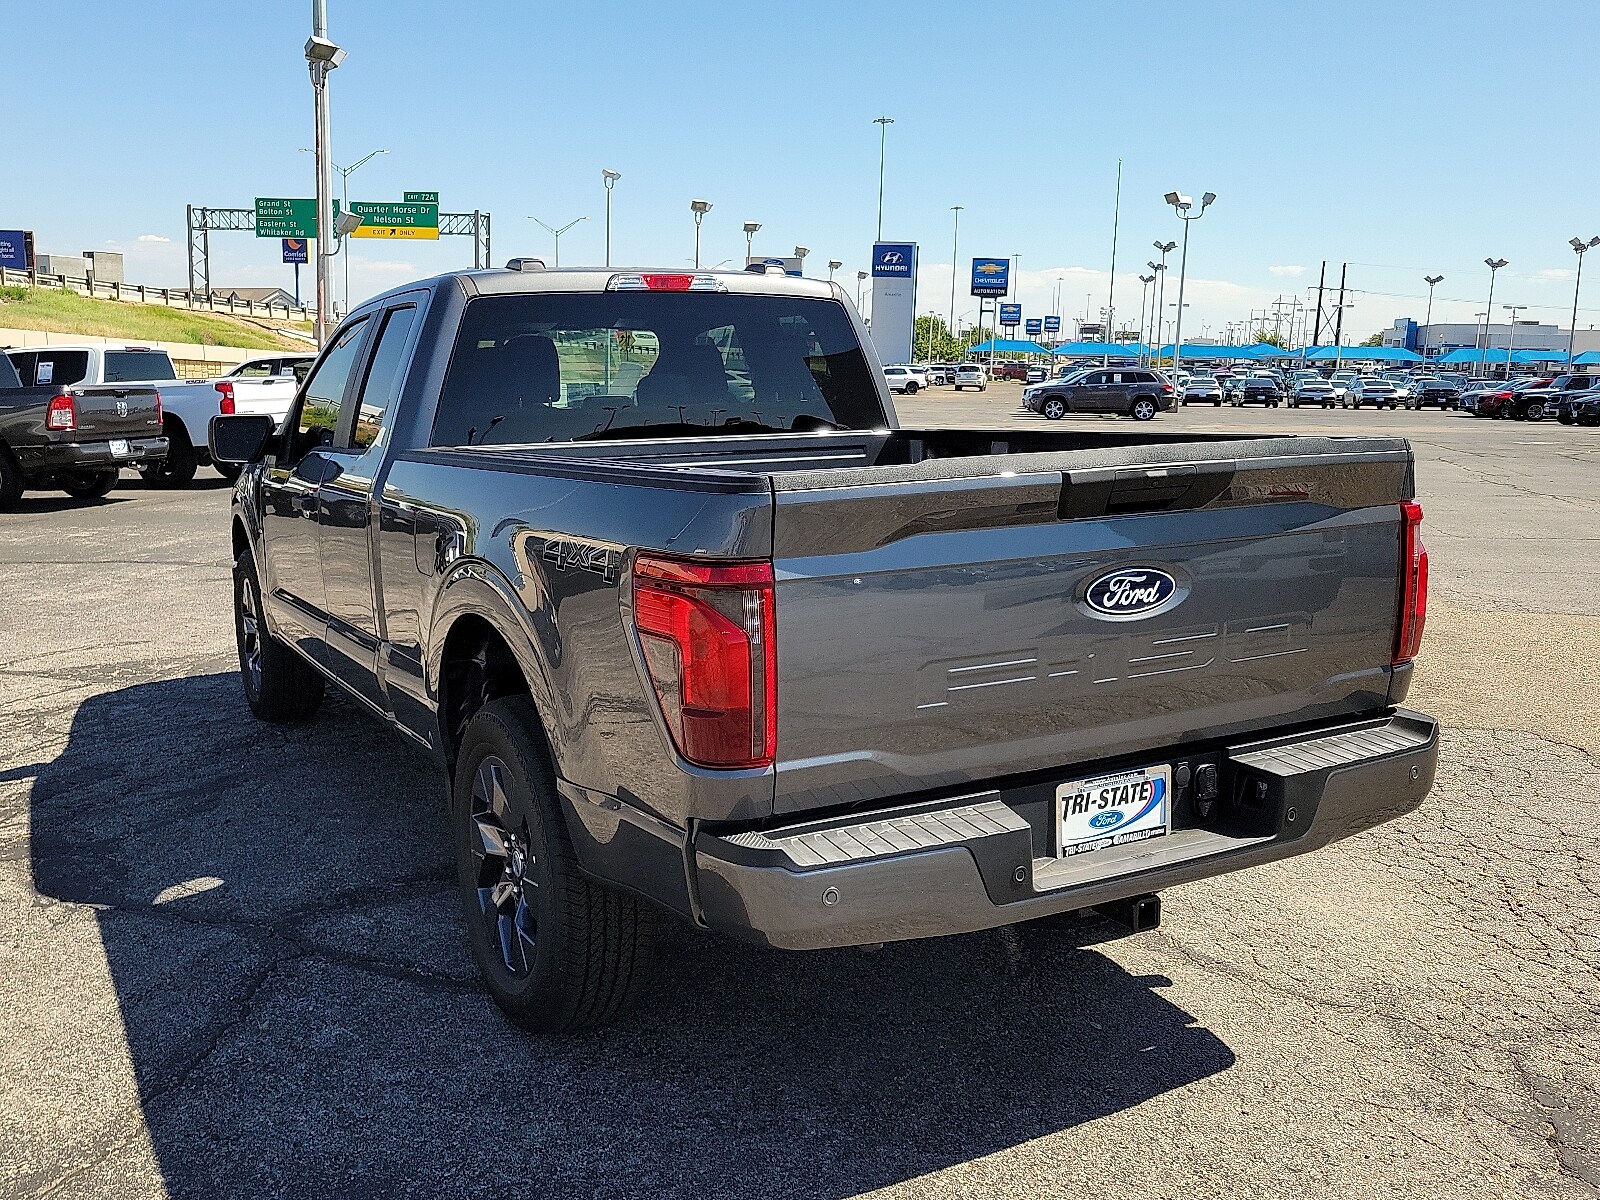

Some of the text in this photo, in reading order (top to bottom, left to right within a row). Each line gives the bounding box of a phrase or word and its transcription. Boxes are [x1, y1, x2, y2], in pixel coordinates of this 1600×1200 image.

[421, 193, 435, 201] 72A
[283, 200, 291, 208] St
[285, 208, 294, 216] St
[357, 205, 430, 214] Quarter Horse Dr
[373, 215, 415, 224] Nelson St
[259, 220, 287, 228] Eastern
[259, 228, 292, 236] Whitaker
[283, 250, 307, 258] Comfort
[875, 264, 908, 272] HYUNDAI
[1103, 573, 1161, 609] Ford
[1061, 780, 1150, 822] TRI-STATE
[1095, 811, 1118, 827] Ford
[1064, 843, 1097, 857] TRI-STATE
